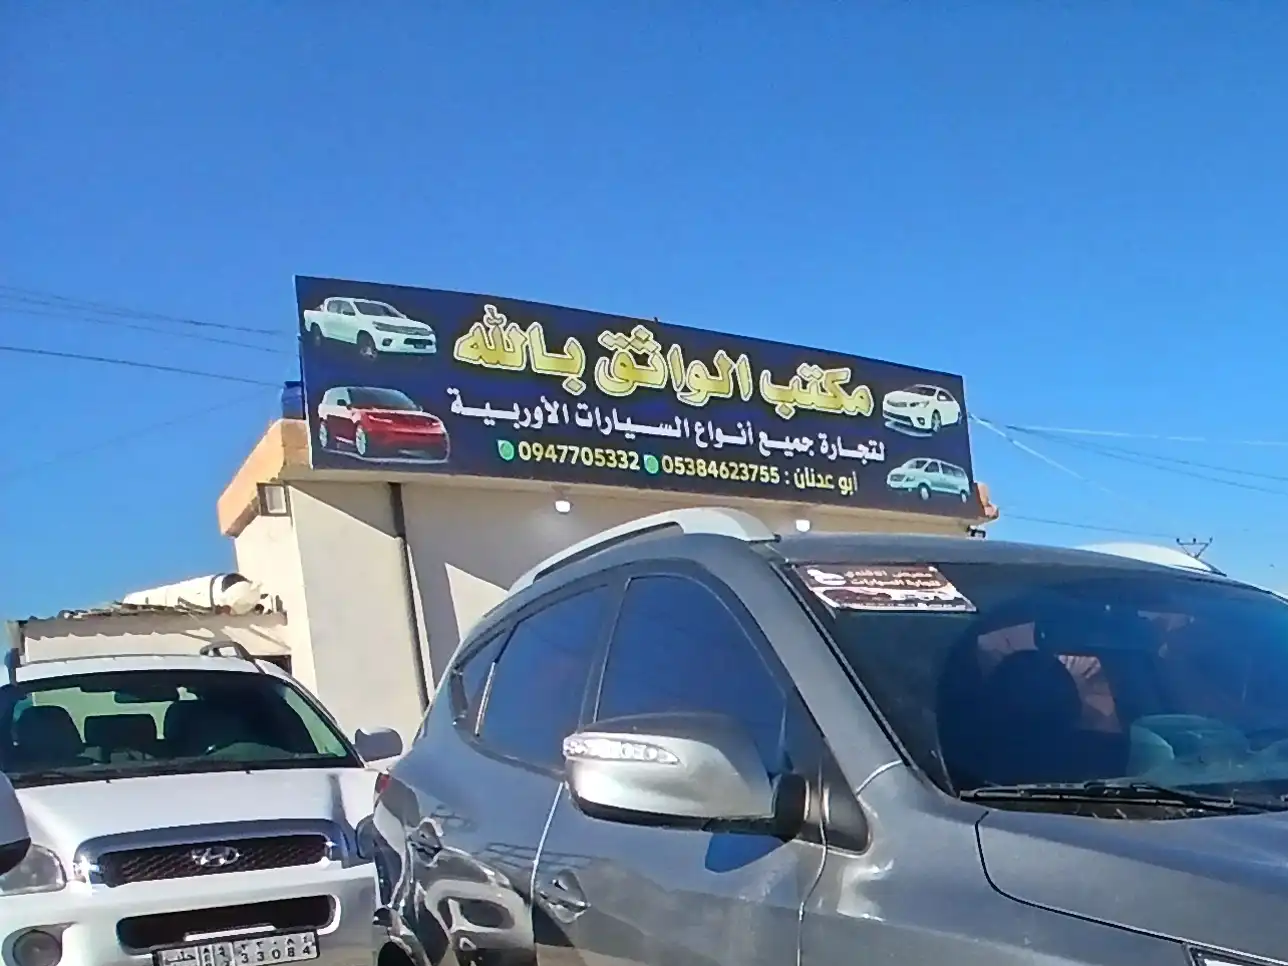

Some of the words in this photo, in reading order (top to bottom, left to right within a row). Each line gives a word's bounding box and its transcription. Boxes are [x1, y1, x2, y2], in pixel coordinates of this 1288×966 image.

[453, 304, 587, 396] بالله
[594, 325, 753, 407] الواثق
[759, 362, 874, 420] مكتب
[446, 387, 570, 430] الأوربية
[575, 401, 690, 440] السيارات
[517, 441, 640, 471] 0947705332
[758, 431, 814, 457] جميع
[817, 432, 886, 465] لتجارة
[661, 455, 781, 485] 05384623755
[793, 466, 835, 490] عدنان
[241, 945, 311, 963] 33084
